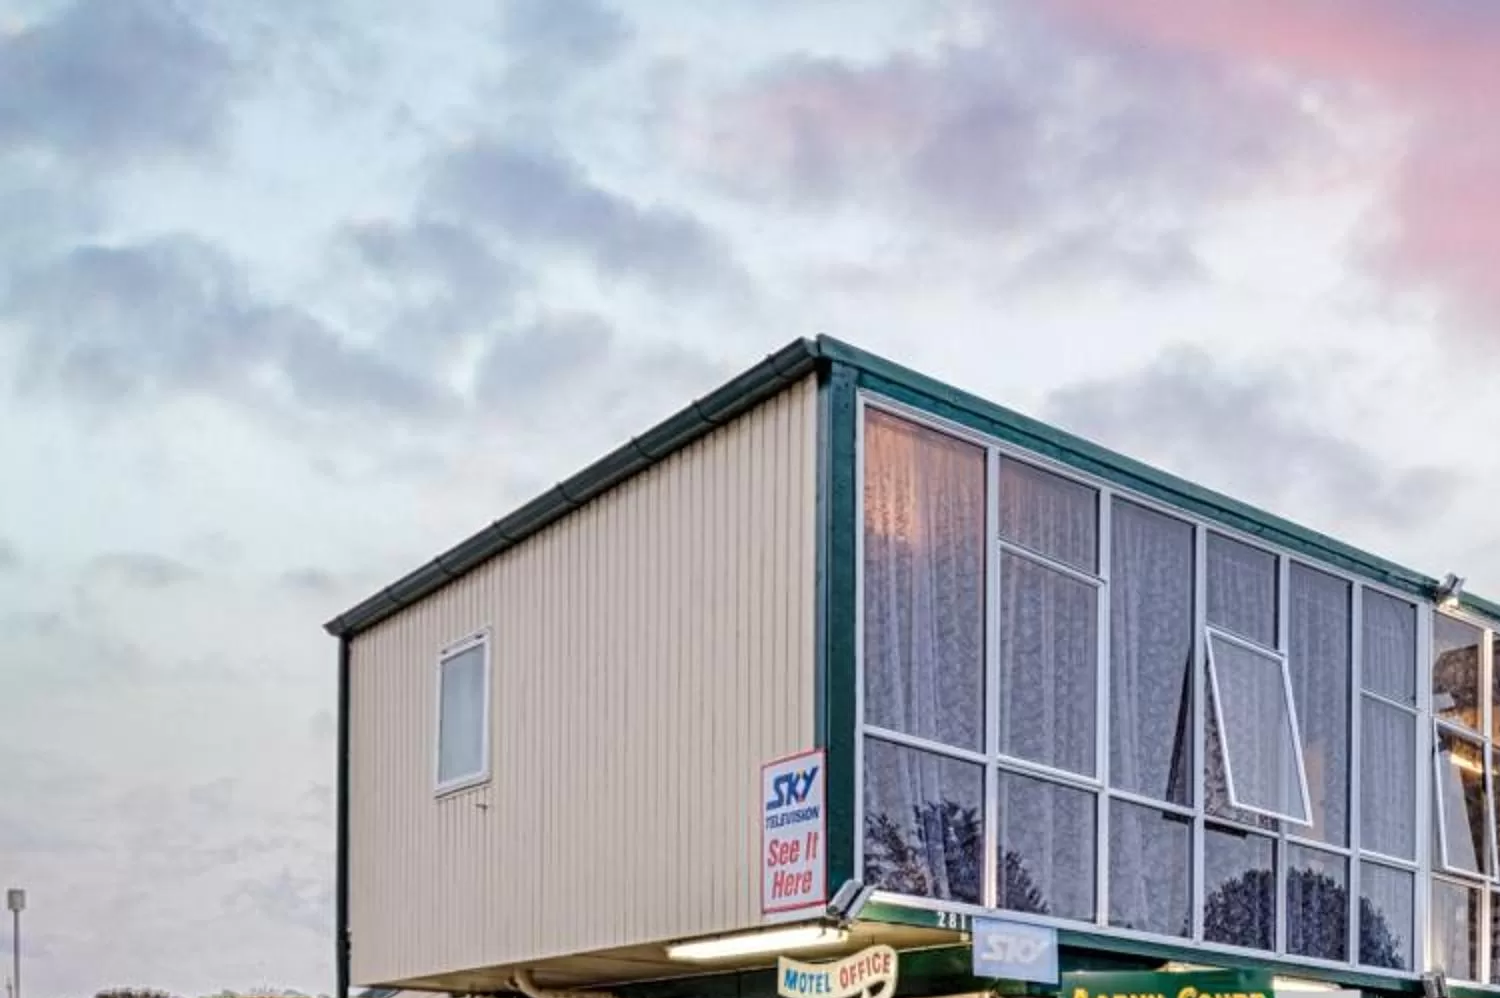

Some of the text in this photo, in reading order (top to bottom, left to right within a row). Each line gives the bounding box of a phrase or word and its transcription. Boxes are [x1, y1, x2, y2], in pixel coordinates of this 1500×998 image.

[765, 766, 820, 810] SKY
[766, 806, 820, 830] TELEVISION
[767, 831, 819, 868] See It
[771, 869, 813, 899] Here
[937, 911, 966, 929] 281
[980, 933, 1050, 965] SKY
[784, 952, 890, 993] MOTEL OFFICE
